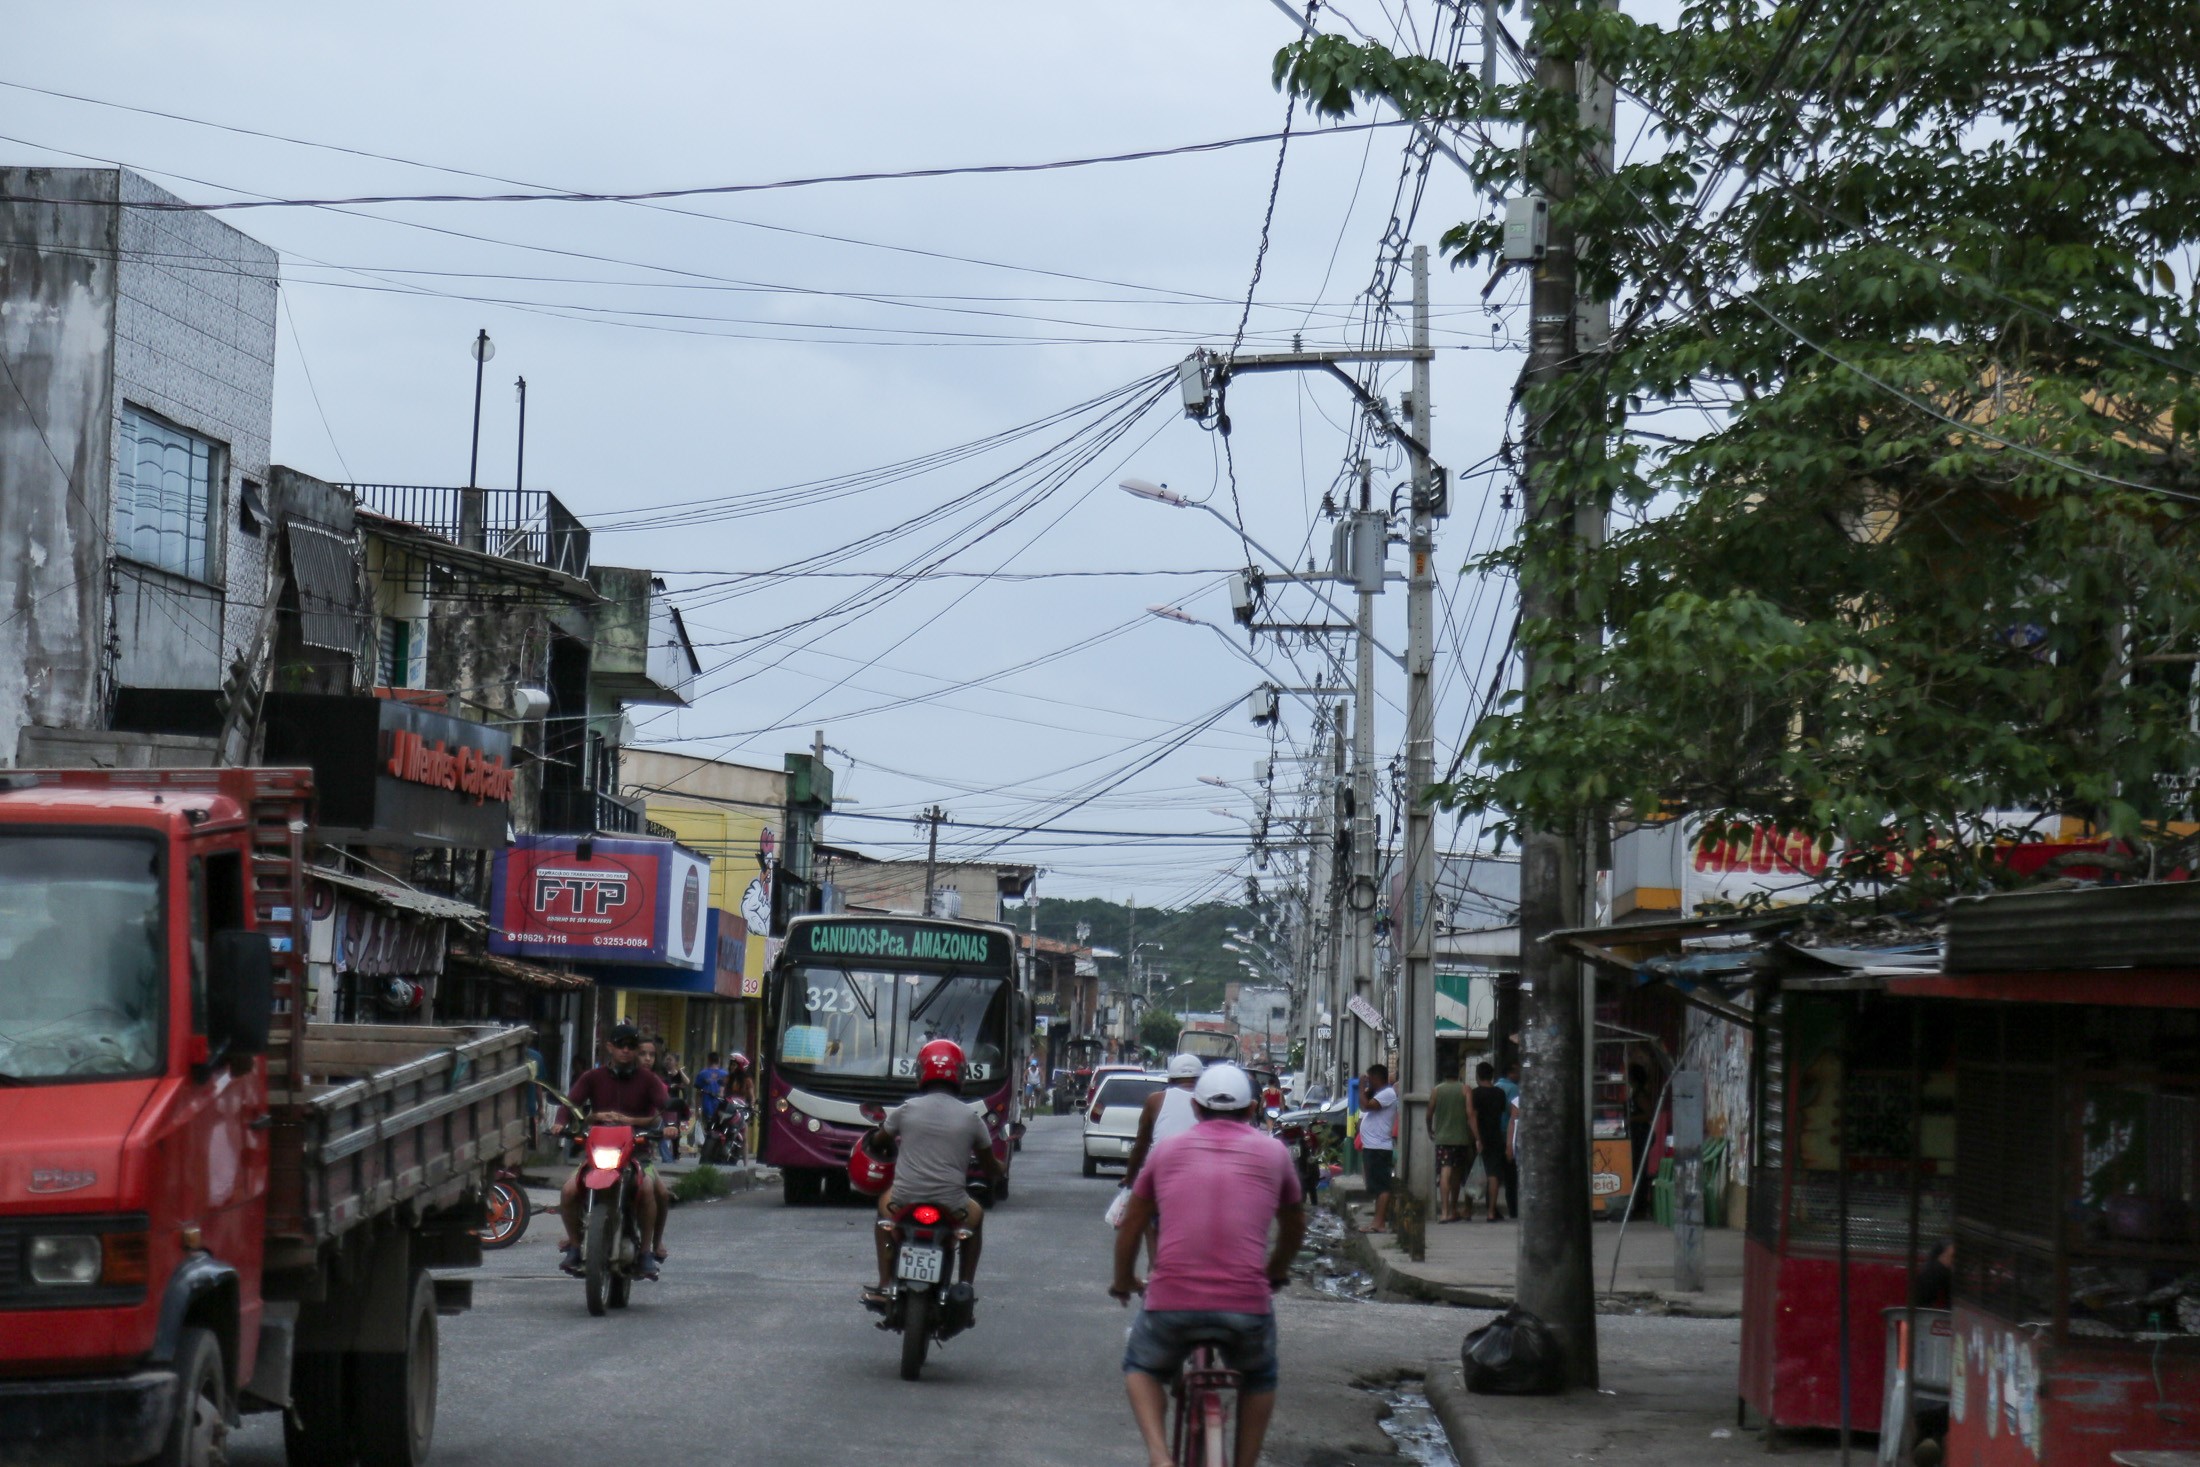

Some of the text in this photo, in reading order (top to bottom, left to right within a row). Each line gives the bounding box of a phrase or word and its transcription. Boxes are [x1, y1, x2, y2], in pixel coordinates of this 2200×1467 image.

[388, 729, 515, 807] J Mendes Calçados
[1695, 820, 1829, 877] ALUGO
[534, 878, 627, 915] FTP
[603, 937, 648, 947] 3253-0084
[911, 931, 987, 962] AMAZONAS
[743, 979, 759, 994] 39
[804, 987, 857, 1014] 323
[904, 1266, 934, 1281] 1101
